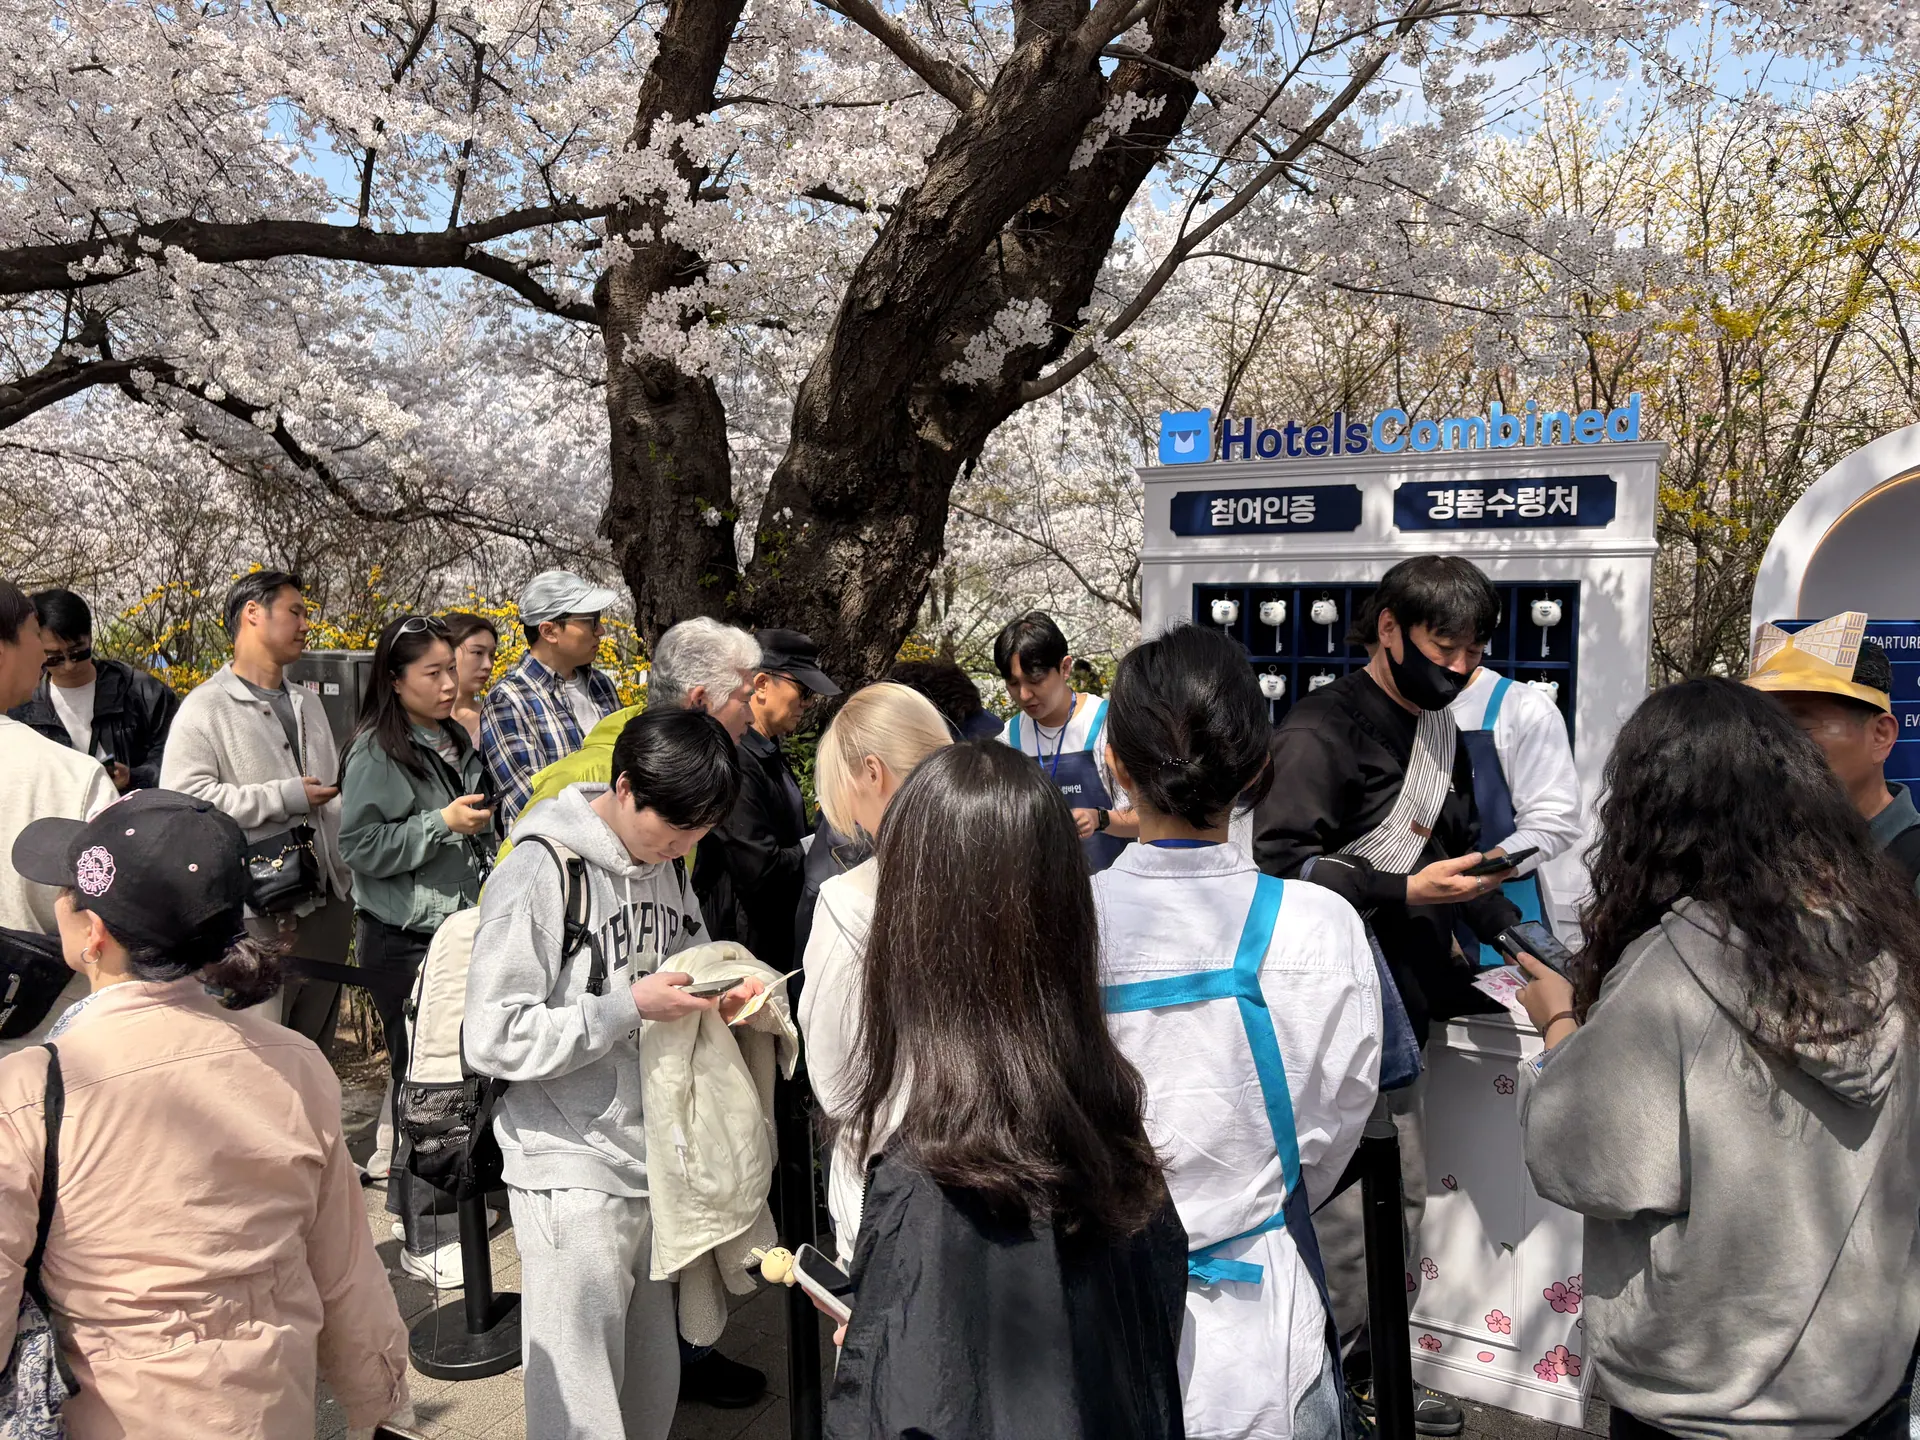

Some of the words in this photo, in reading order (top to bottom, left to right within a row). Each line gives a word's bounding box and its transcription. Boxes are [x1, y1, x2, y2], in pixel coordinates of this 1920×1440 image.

[1222, 392, 1642, 461] HotelsCombined
[1210, 495, 1316, 526] 참여인증
[1427, 485, 1578, 520] 경품수령처
[1905, 714, 1920, 727] EV
